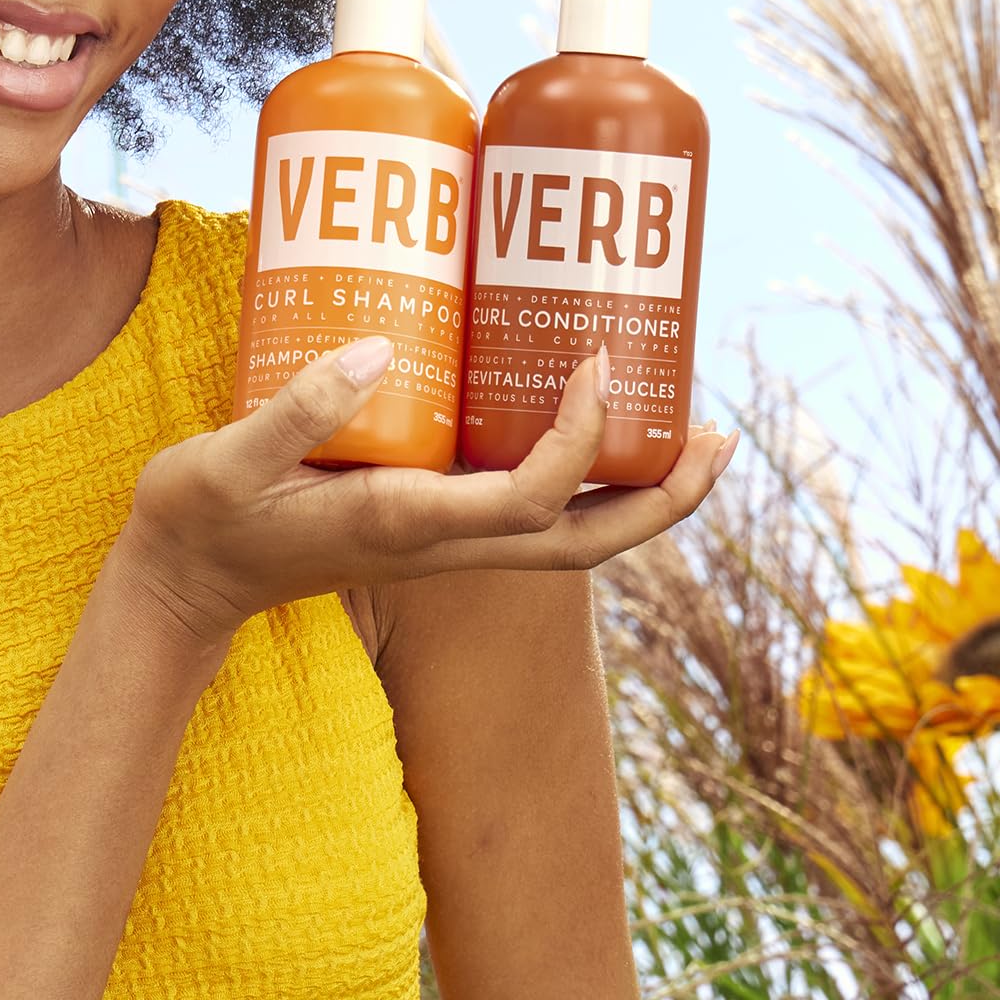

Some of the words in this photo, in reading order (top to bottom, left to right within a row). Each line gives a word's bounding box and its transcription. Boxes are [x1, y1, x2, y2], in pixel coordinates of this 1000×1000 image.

[279, 155, 460, 255] VERB
[491, 171, 673, 269] VERB
[256, 273, 308, 287] CLEANSE
[336, 274, 394, 287] DEFINE
[255, 288, 314, 310] CURL
[332, 288, 461, 328] SHAMPOO
[474, 292, 509, 301] SOFTEN
[531, 295, 613, 309] DETANGLE
[639, 303, 681, 315] DEFINE
[292, 312, 326, 320] ALL
[347, 313, 399, 327] CURL
[472, 307, 511, 326] CURL
[518, 309, 680, 339] CONDITIONER
[250, 335, 290, 348] NETTOIE
[503, 333, 534, 342] ALL
[627, 341, 678, 354] TYPES
[537, 358, 578, 369] DÉMÊ
[626, 365, 676, 376] DÉFINIT
[247, 373, 270, 384] POUR
[395, 379, 409, 389] DE
[416, 383, 455, 403] BOUCLES
[609, 379, 675, 399] OUCLES
[489, 393, 516, 402] TOUS
[522, 395, 545, 404] LES
[626, 402, 674, 414] BOUCLES
[646, 428, 662, 439] 355
[662, 429, 672, 439] ml
